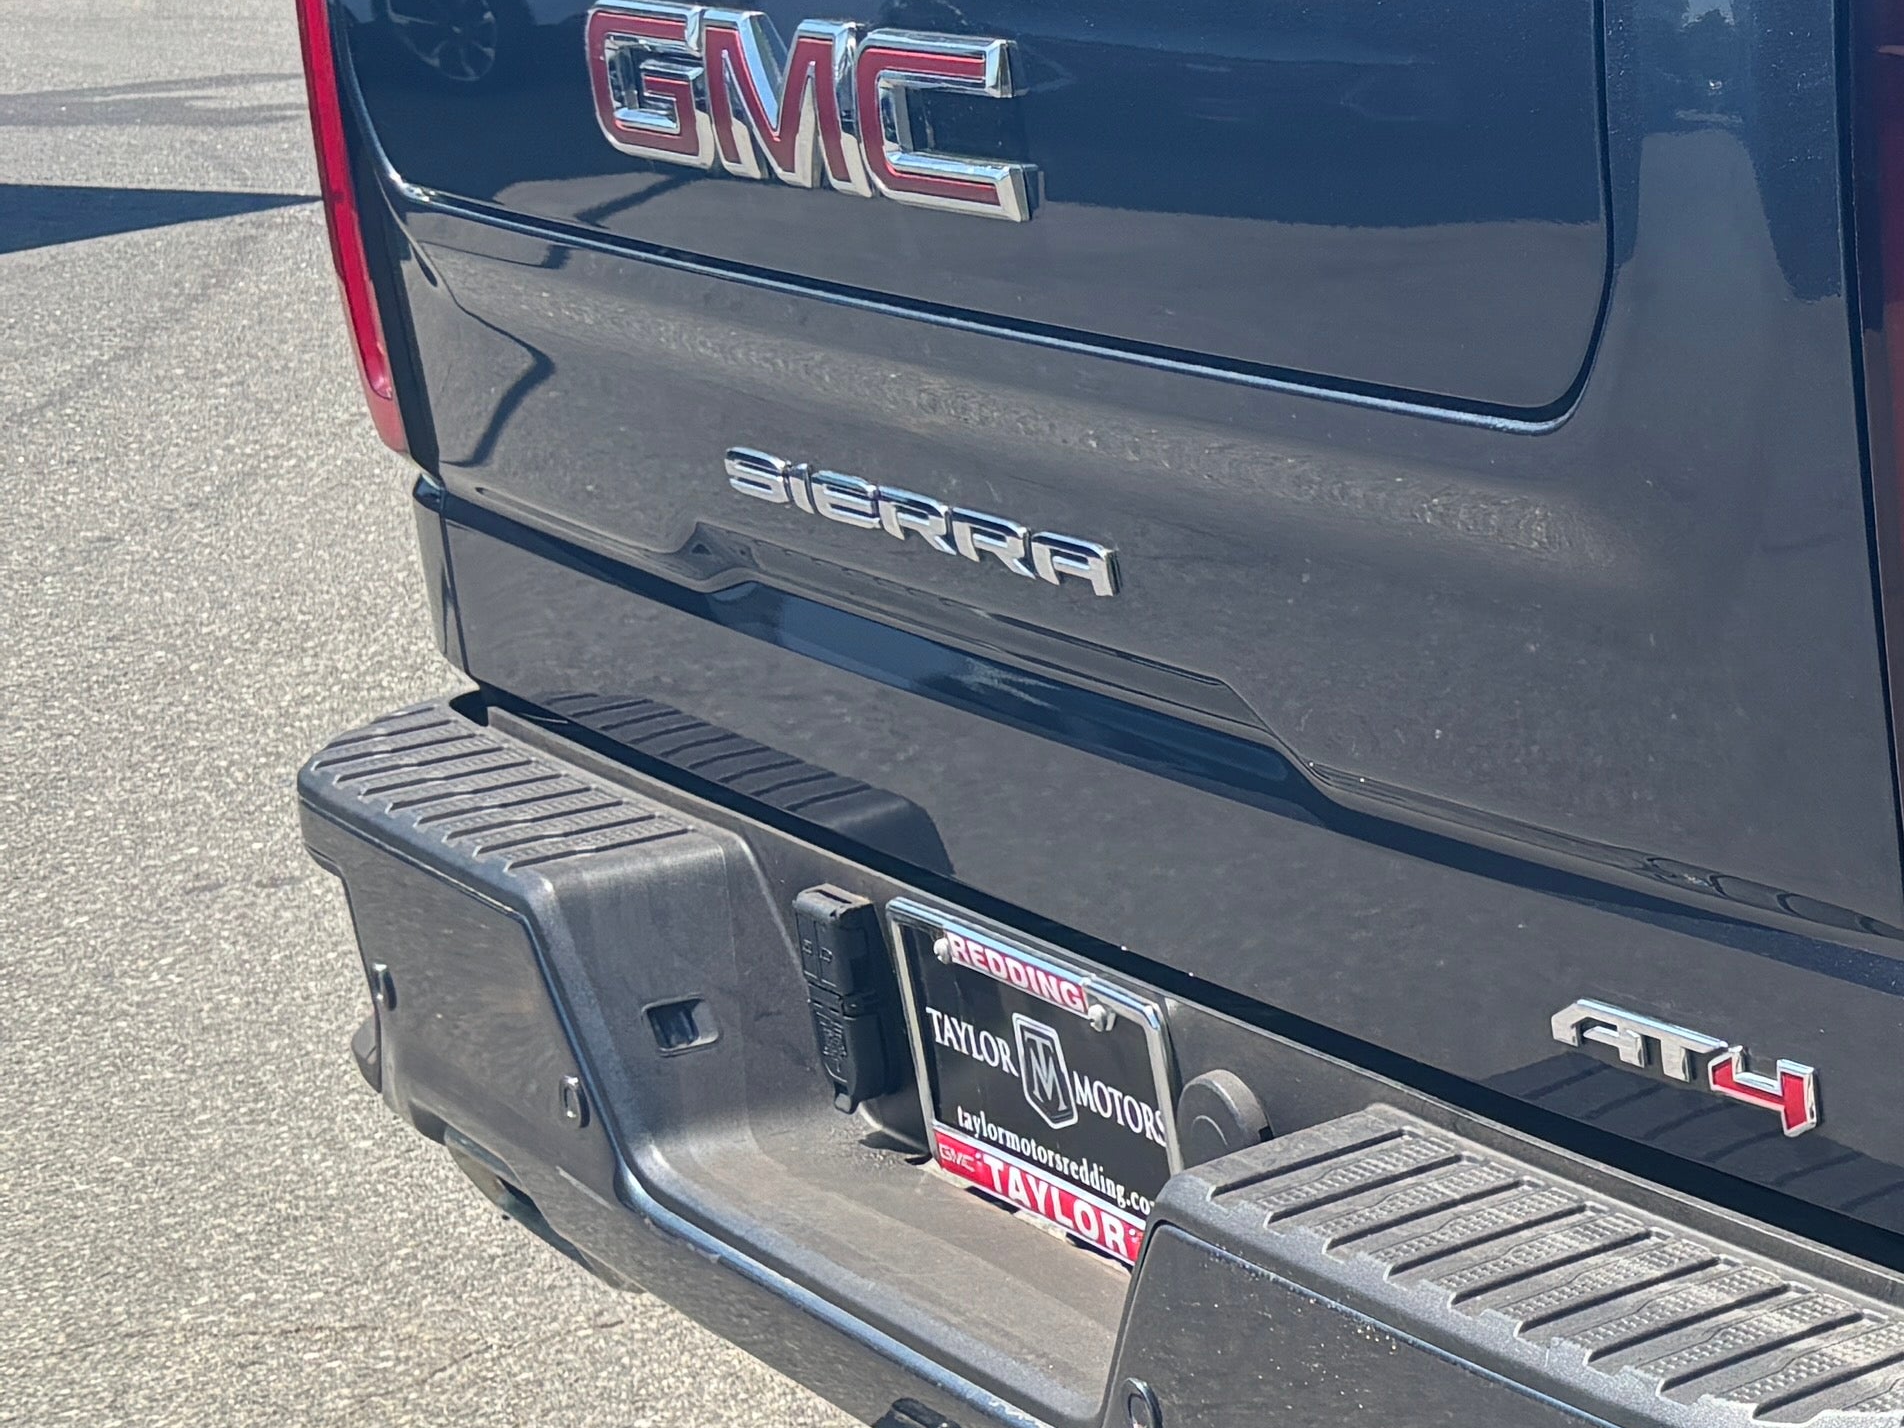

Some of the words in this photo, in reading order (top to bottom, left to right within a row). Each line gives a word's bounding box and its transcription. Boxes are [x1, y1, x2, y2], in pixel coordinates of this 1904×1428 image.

[724, 446, 1119, 597] SIERRA
[947, 933, 1089, 1016] REDDING
[925, 1006, 1020, 1078] TAYLOR
[1072, 1070, 1167, 1148] MOTORS
[1551, 998, 1817, 1138] AT4
[956, 1105, 1155, 1216] taylormotorsredding.co
[981, 1155, 1130, 1259] TAYLOR
